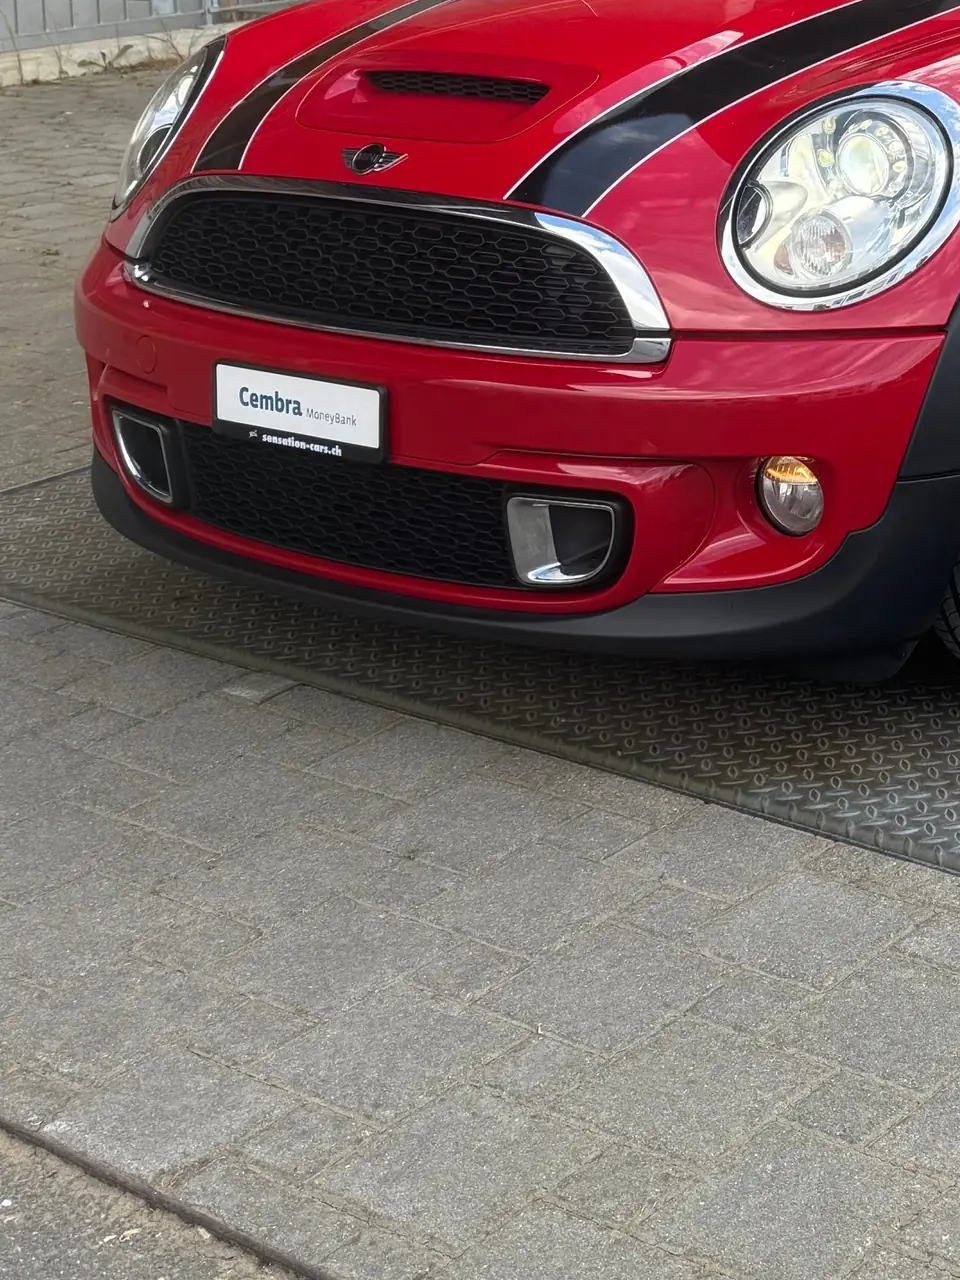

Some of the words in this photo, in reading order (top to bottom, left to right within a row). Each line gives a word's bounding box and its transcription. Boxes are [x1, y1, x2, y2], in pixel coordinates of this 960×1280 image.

[239, 386, 303, 417] Cembra
[306, 407, 357, 426] MoneyBank
[262, 433, 342, 457] sensation-cars.ch
